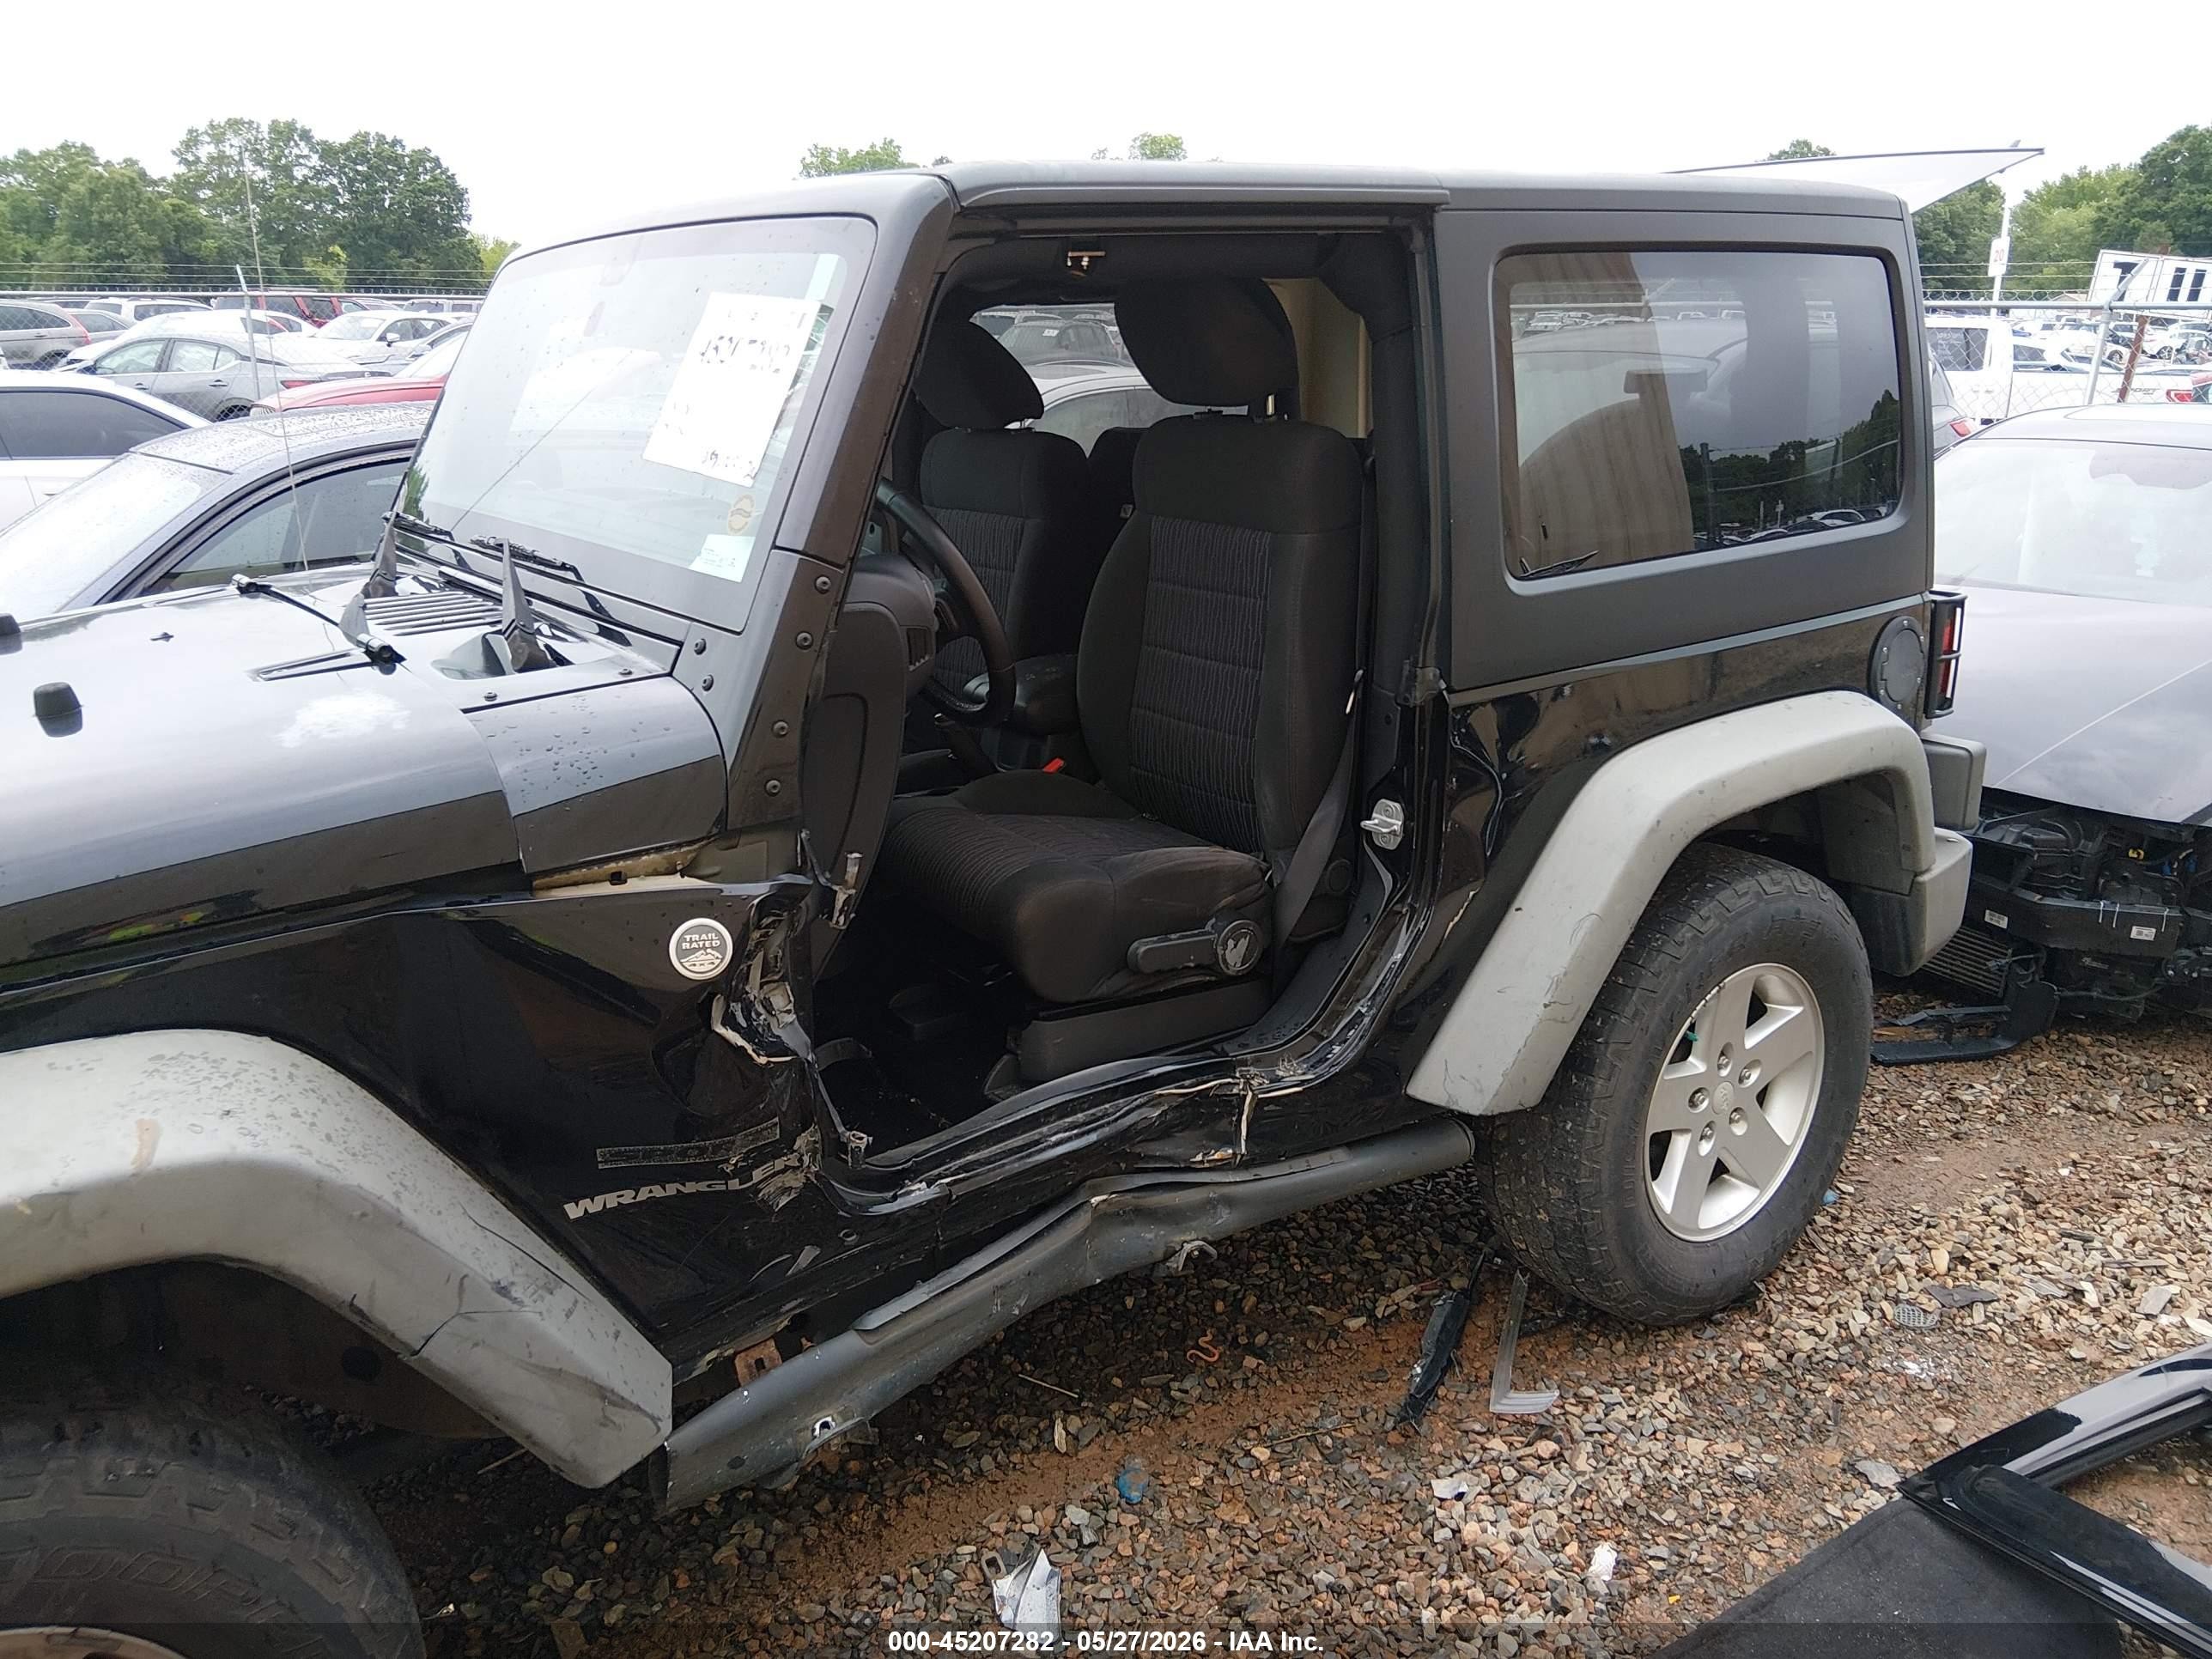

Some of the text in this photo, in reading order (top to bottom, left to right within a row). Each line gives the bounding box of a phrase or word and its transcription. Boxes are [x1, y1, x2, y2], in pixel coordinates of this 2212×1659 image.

[1993, 248, 2005, 263] 20
[684, 933, 719, 942] TRAIL
[681, 940, 720, 950] RATED
[563, 1154, 800, 1220] WRANGLER
